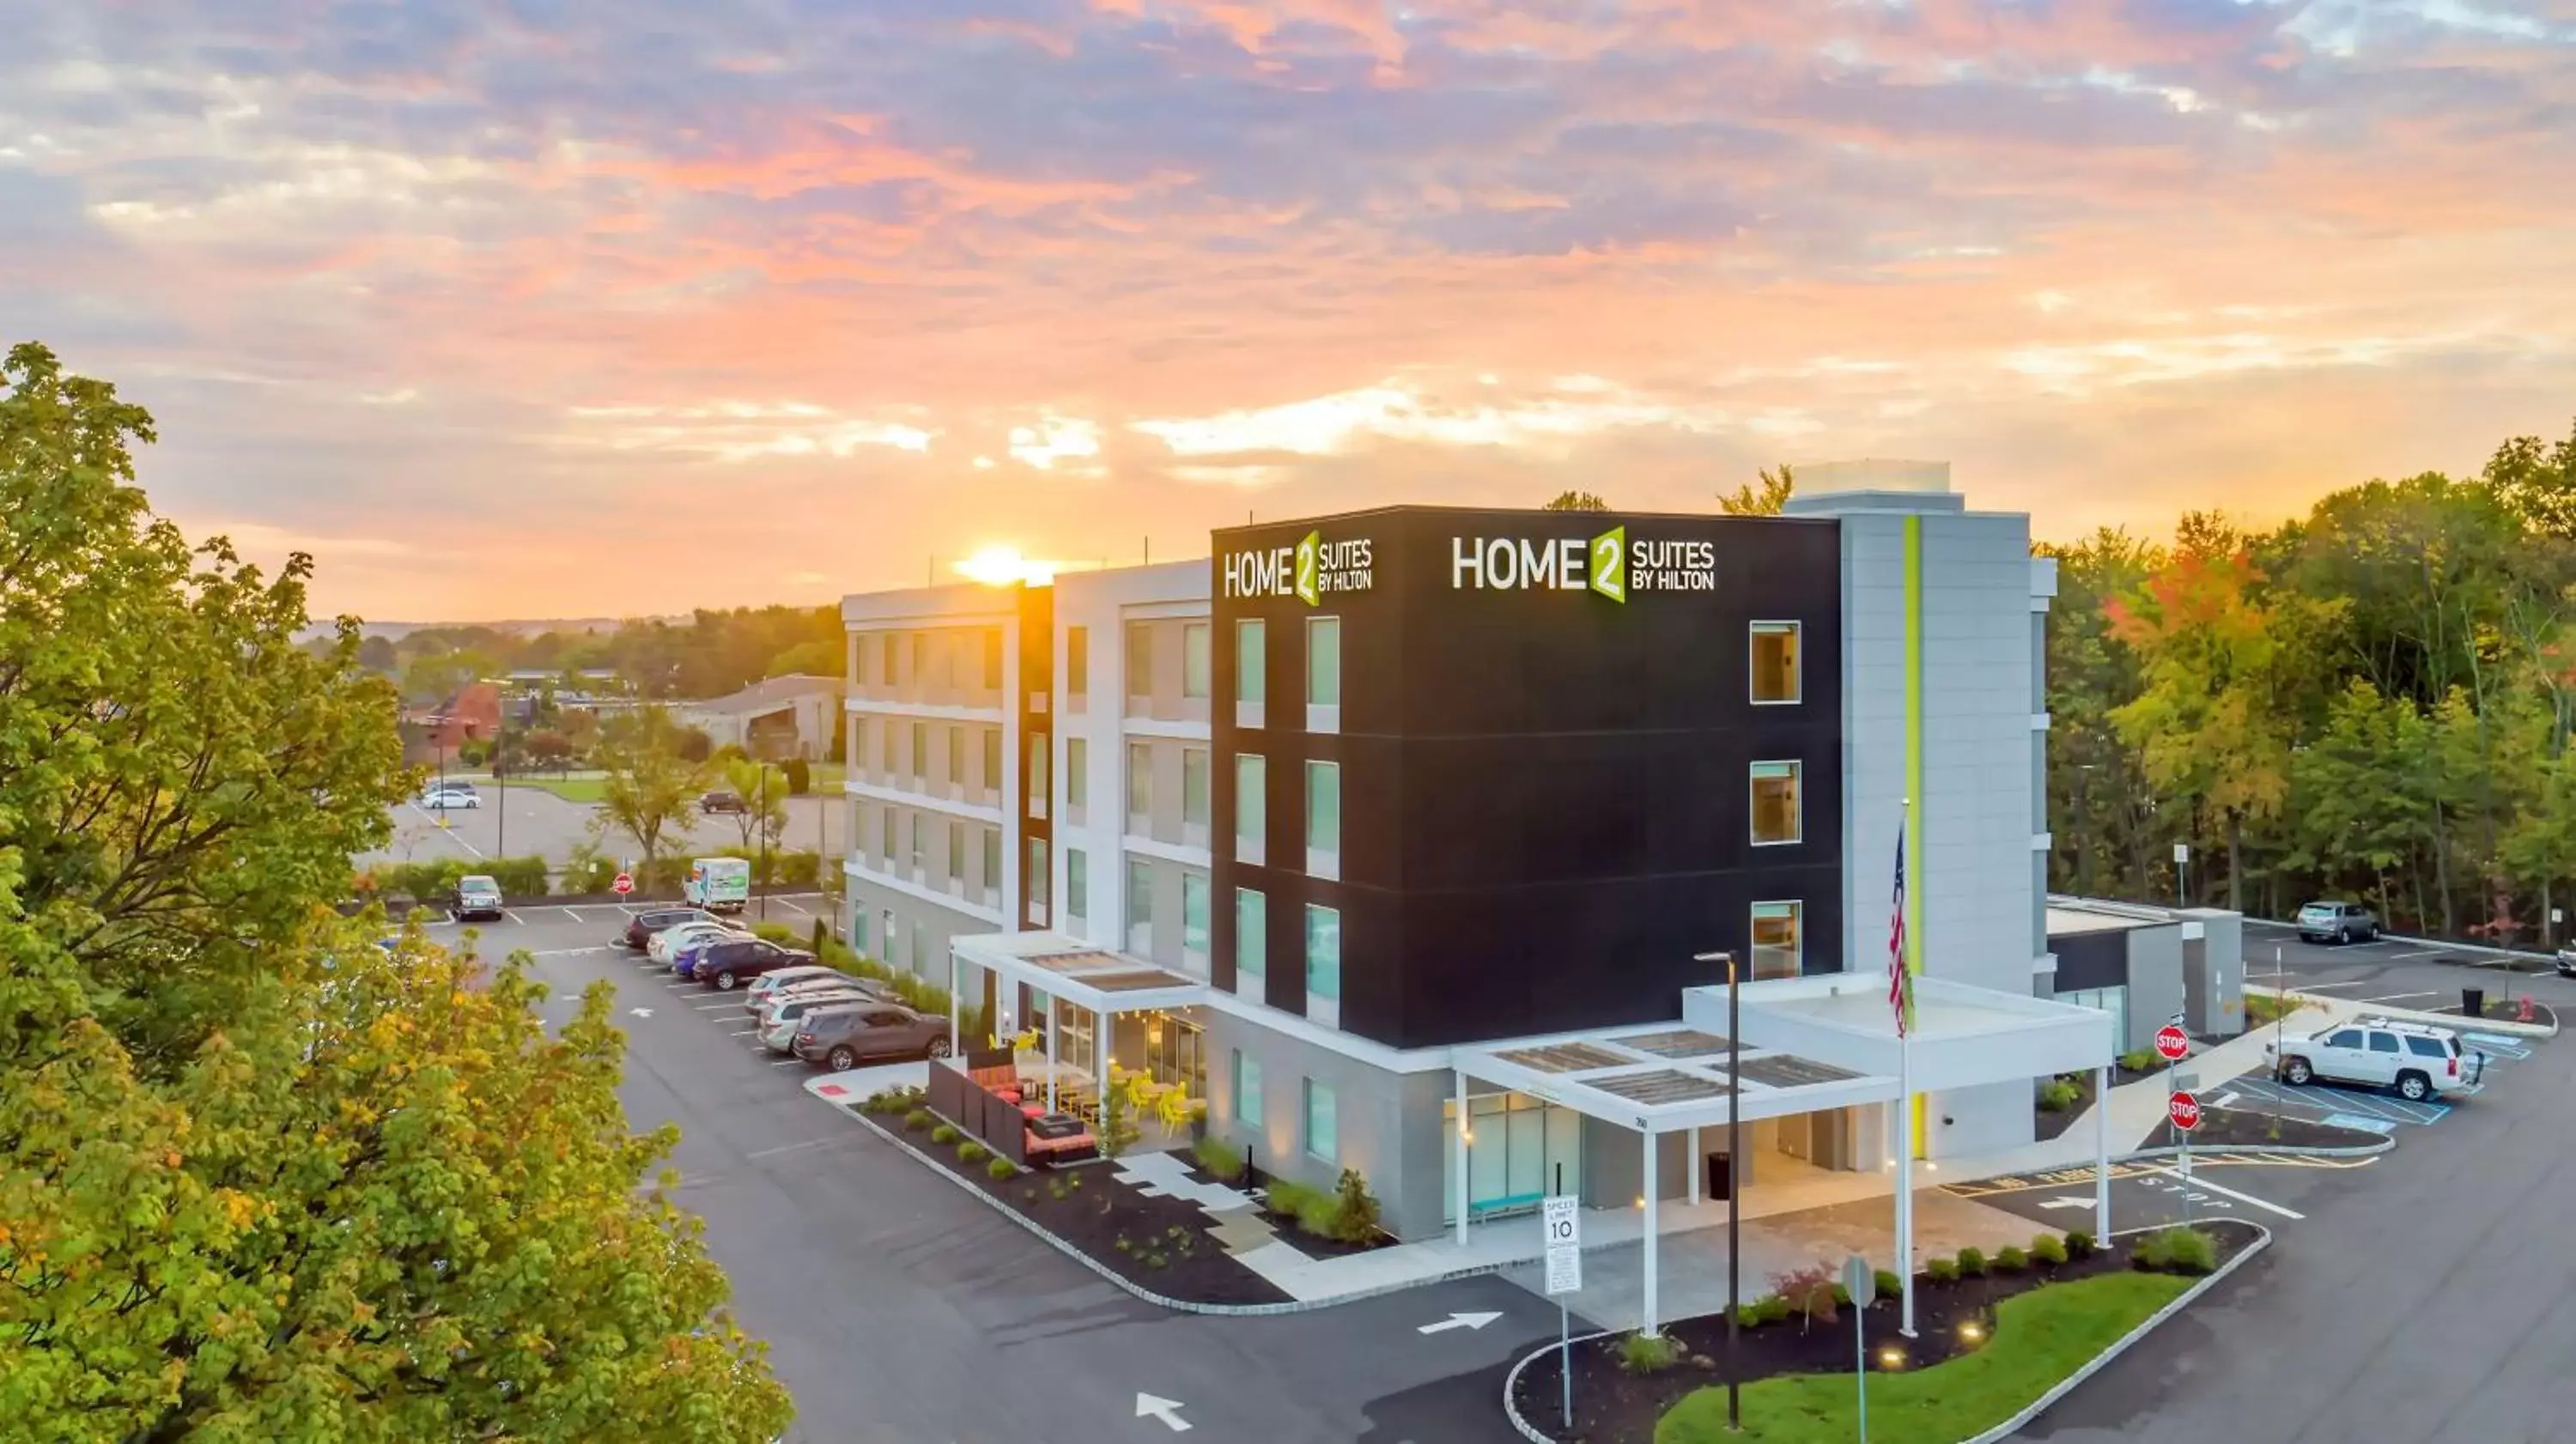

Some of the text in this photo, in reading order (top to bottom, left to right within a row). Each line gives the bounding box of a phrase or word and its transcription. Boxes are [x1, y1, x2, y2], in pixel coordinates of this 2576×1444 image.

[1318, 538, 1372, 571] SUITES
[1452, 537, 1620, 595] HOME 2
[1631, 540, 1715, 569] SUITES
[1224, 541, 1315, 599] HOME 2
[1318, 569, 1372, 592] BY HILTON
[1631, 570, 1715, 591] BY HILTON
[2158, 1034, 2186, 1050] STOP
[2170, 1101, 2198, 1119] STOP
[2137, 1176, 2233, 1208] STOP
[1552, 1220, 1572, 1239] 10
